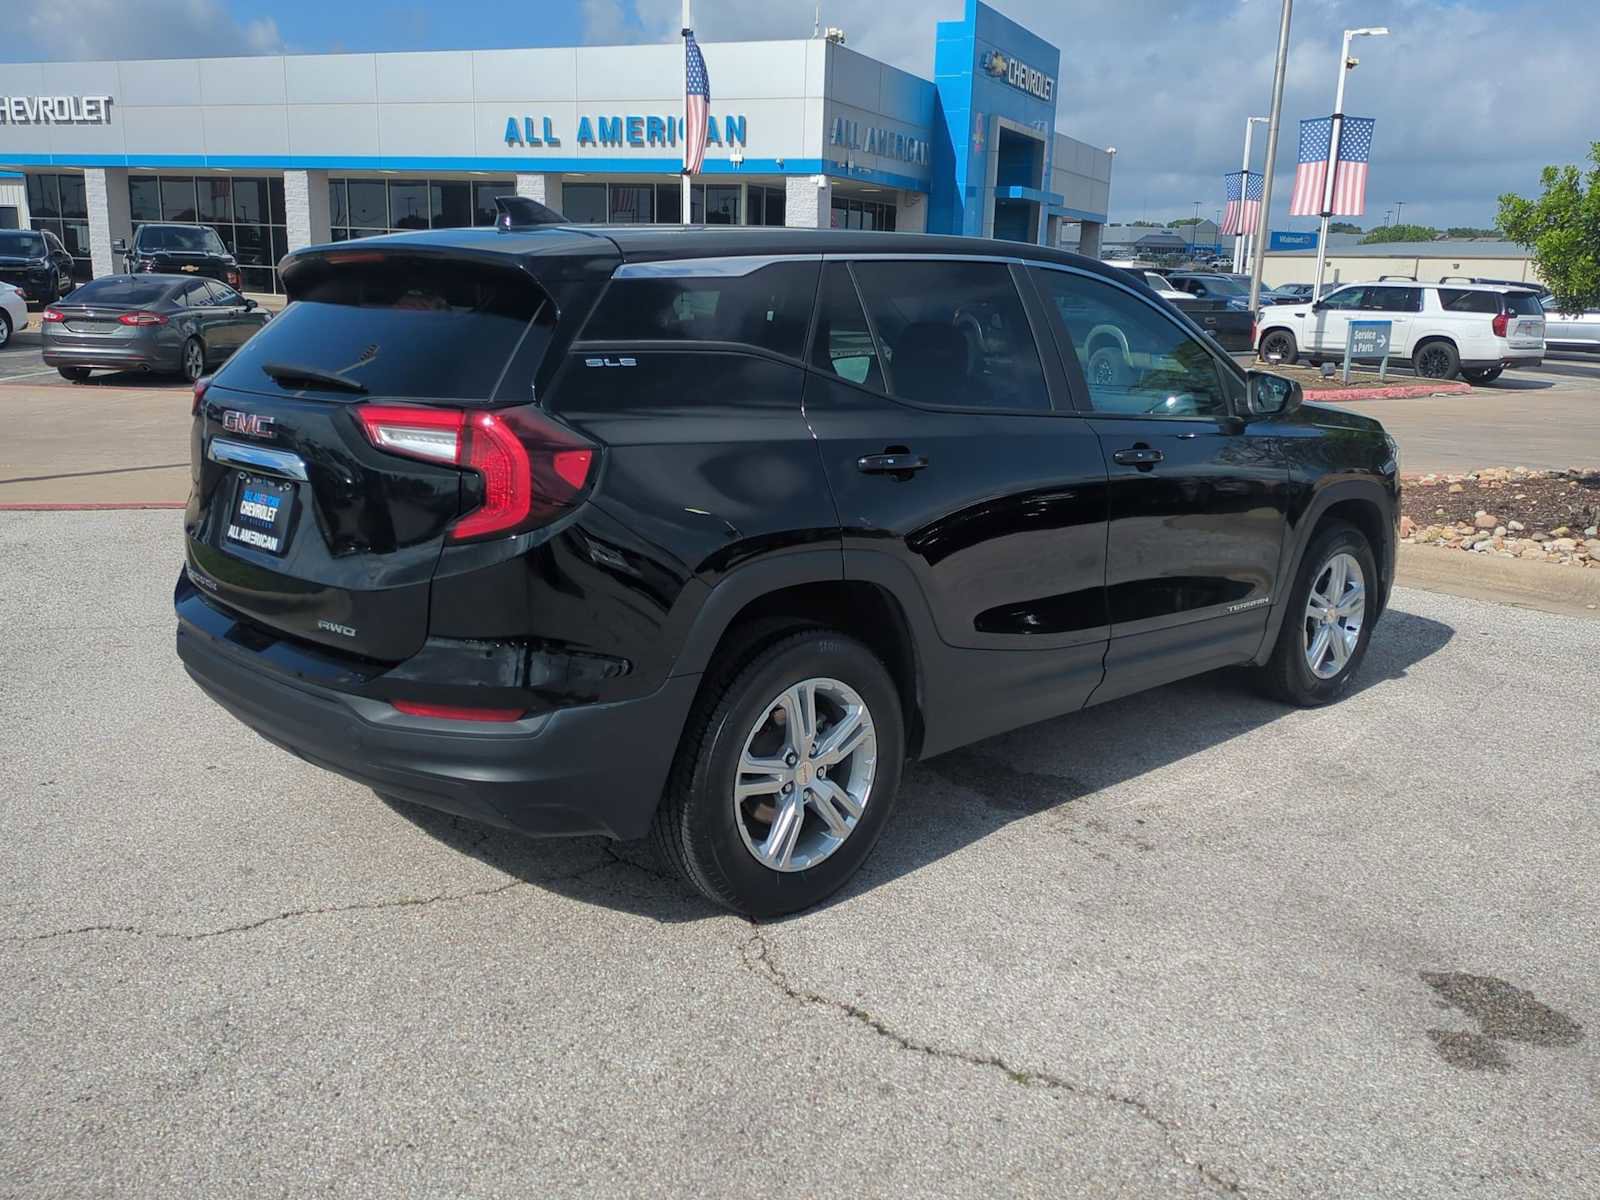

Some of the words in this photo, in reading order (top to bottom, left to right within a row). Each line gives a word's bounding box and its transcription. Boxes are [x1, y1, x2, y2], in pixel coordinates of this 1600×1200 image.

[1008, 58, 1054, 101] CHEVROLET
[504, 116, 560, 147] ALL
[577, 115, 746, 147] AMERIAN
[1354, 330, 1377, 340] Service
[1358, 343, 1374, 352] Parts
[222, 410, 275, 438] GMC
[240, 501, 278, 522] CHEVROLET
[227, 525, 240, 540] ALL
[240, 529, 278, 551] AMERICAN
